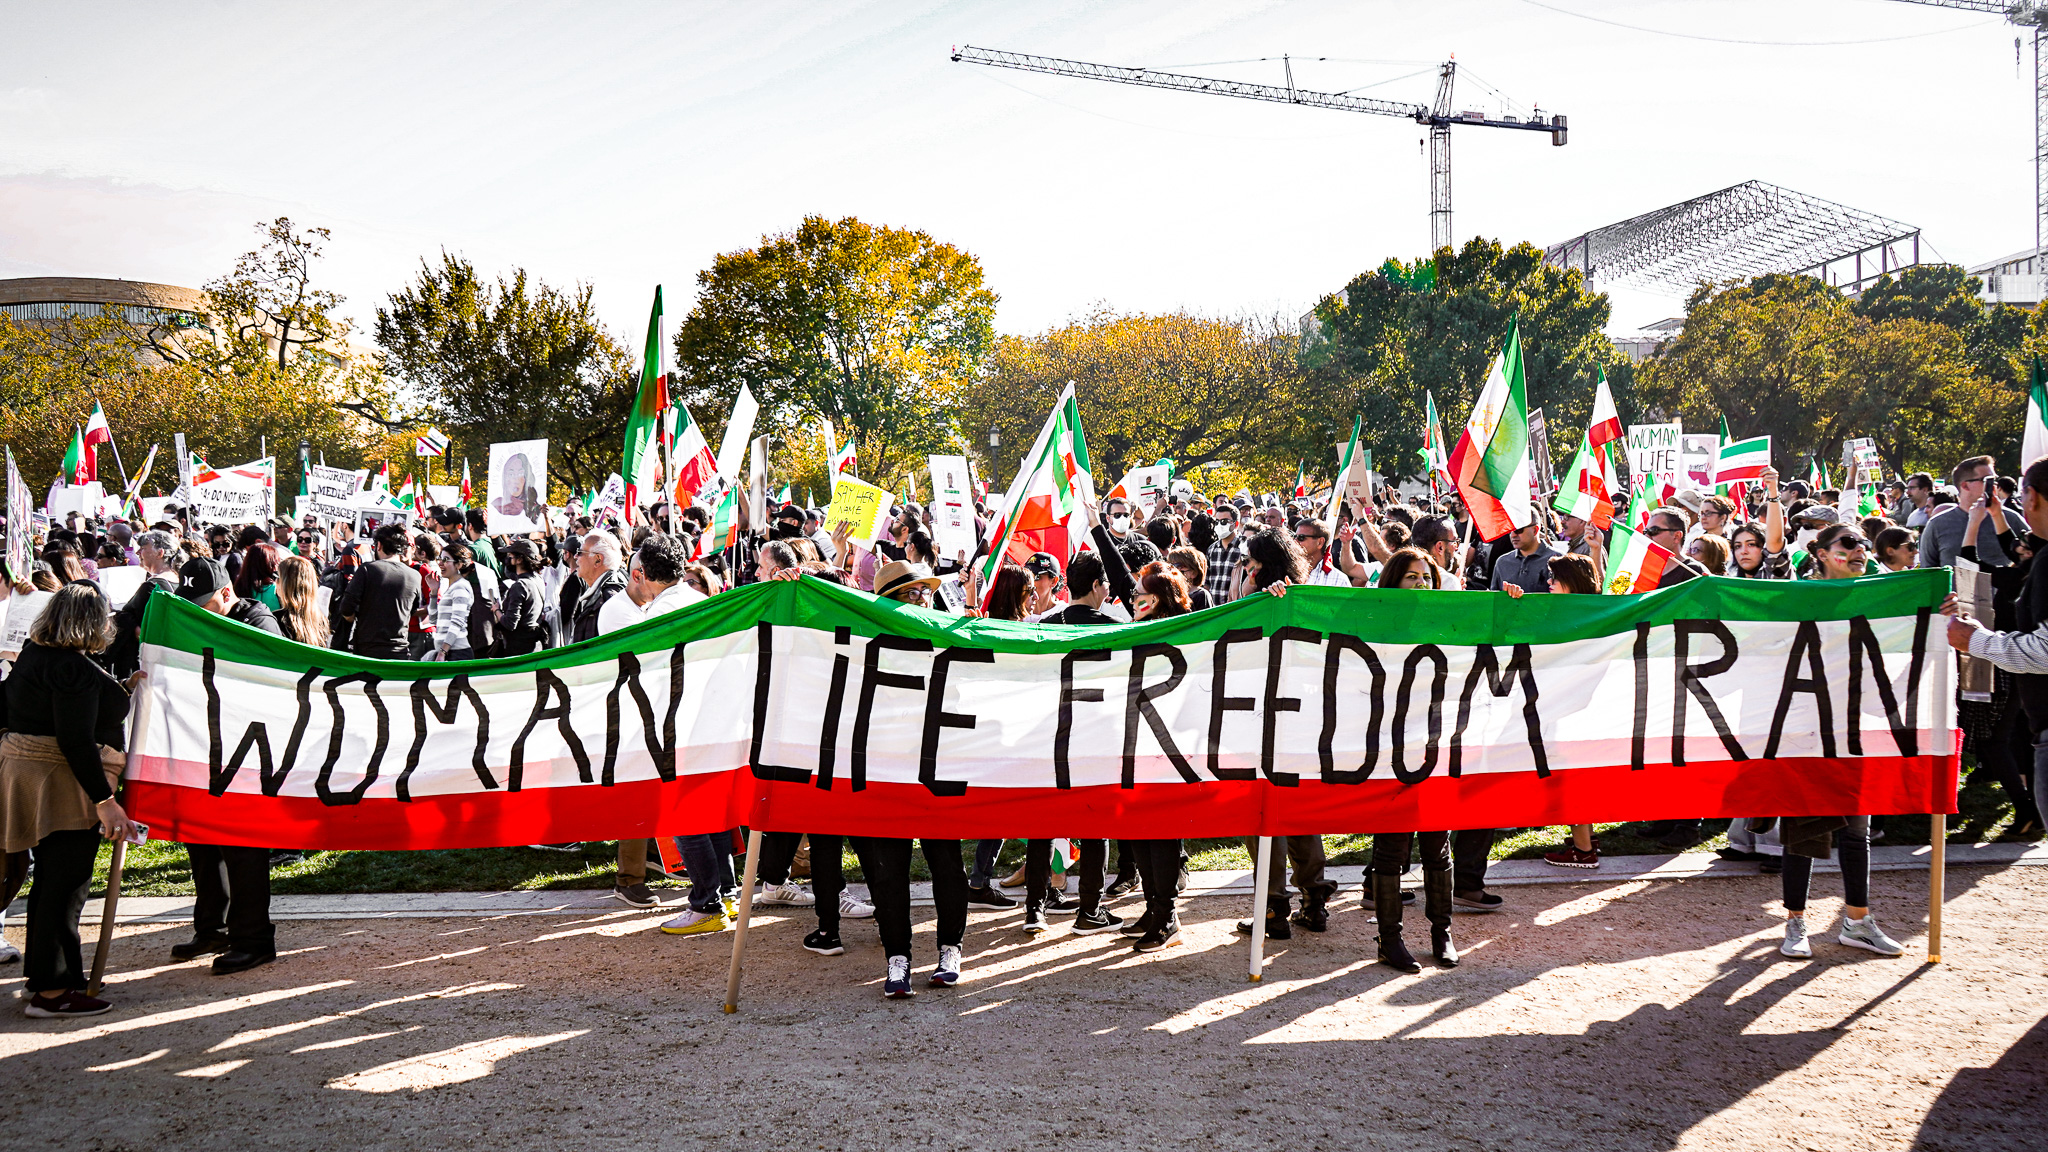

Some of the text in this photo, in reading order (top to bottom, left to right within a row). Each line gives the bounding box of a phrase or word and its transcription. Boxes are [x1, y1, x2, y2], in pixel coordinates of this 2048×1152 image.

[1630, 428, 1679, 449] WOMAN
[1640, 449, 1675, 472] LIFE
[312, 467, 355, 484] ACCURATE
[211, 489, 222, 501] DO
[222, 490, 237, 503] NOT
[317, 485, 347, 500] MEDIA
[834, 485, 874, 504] SAY HER
[838, 505, 861, 515] NAME
[202, 642, 686, 806] WOMAN
[1054, 626, 1551, 786] FREEDOM
[1631, 606, 1932, 770] IRAN
